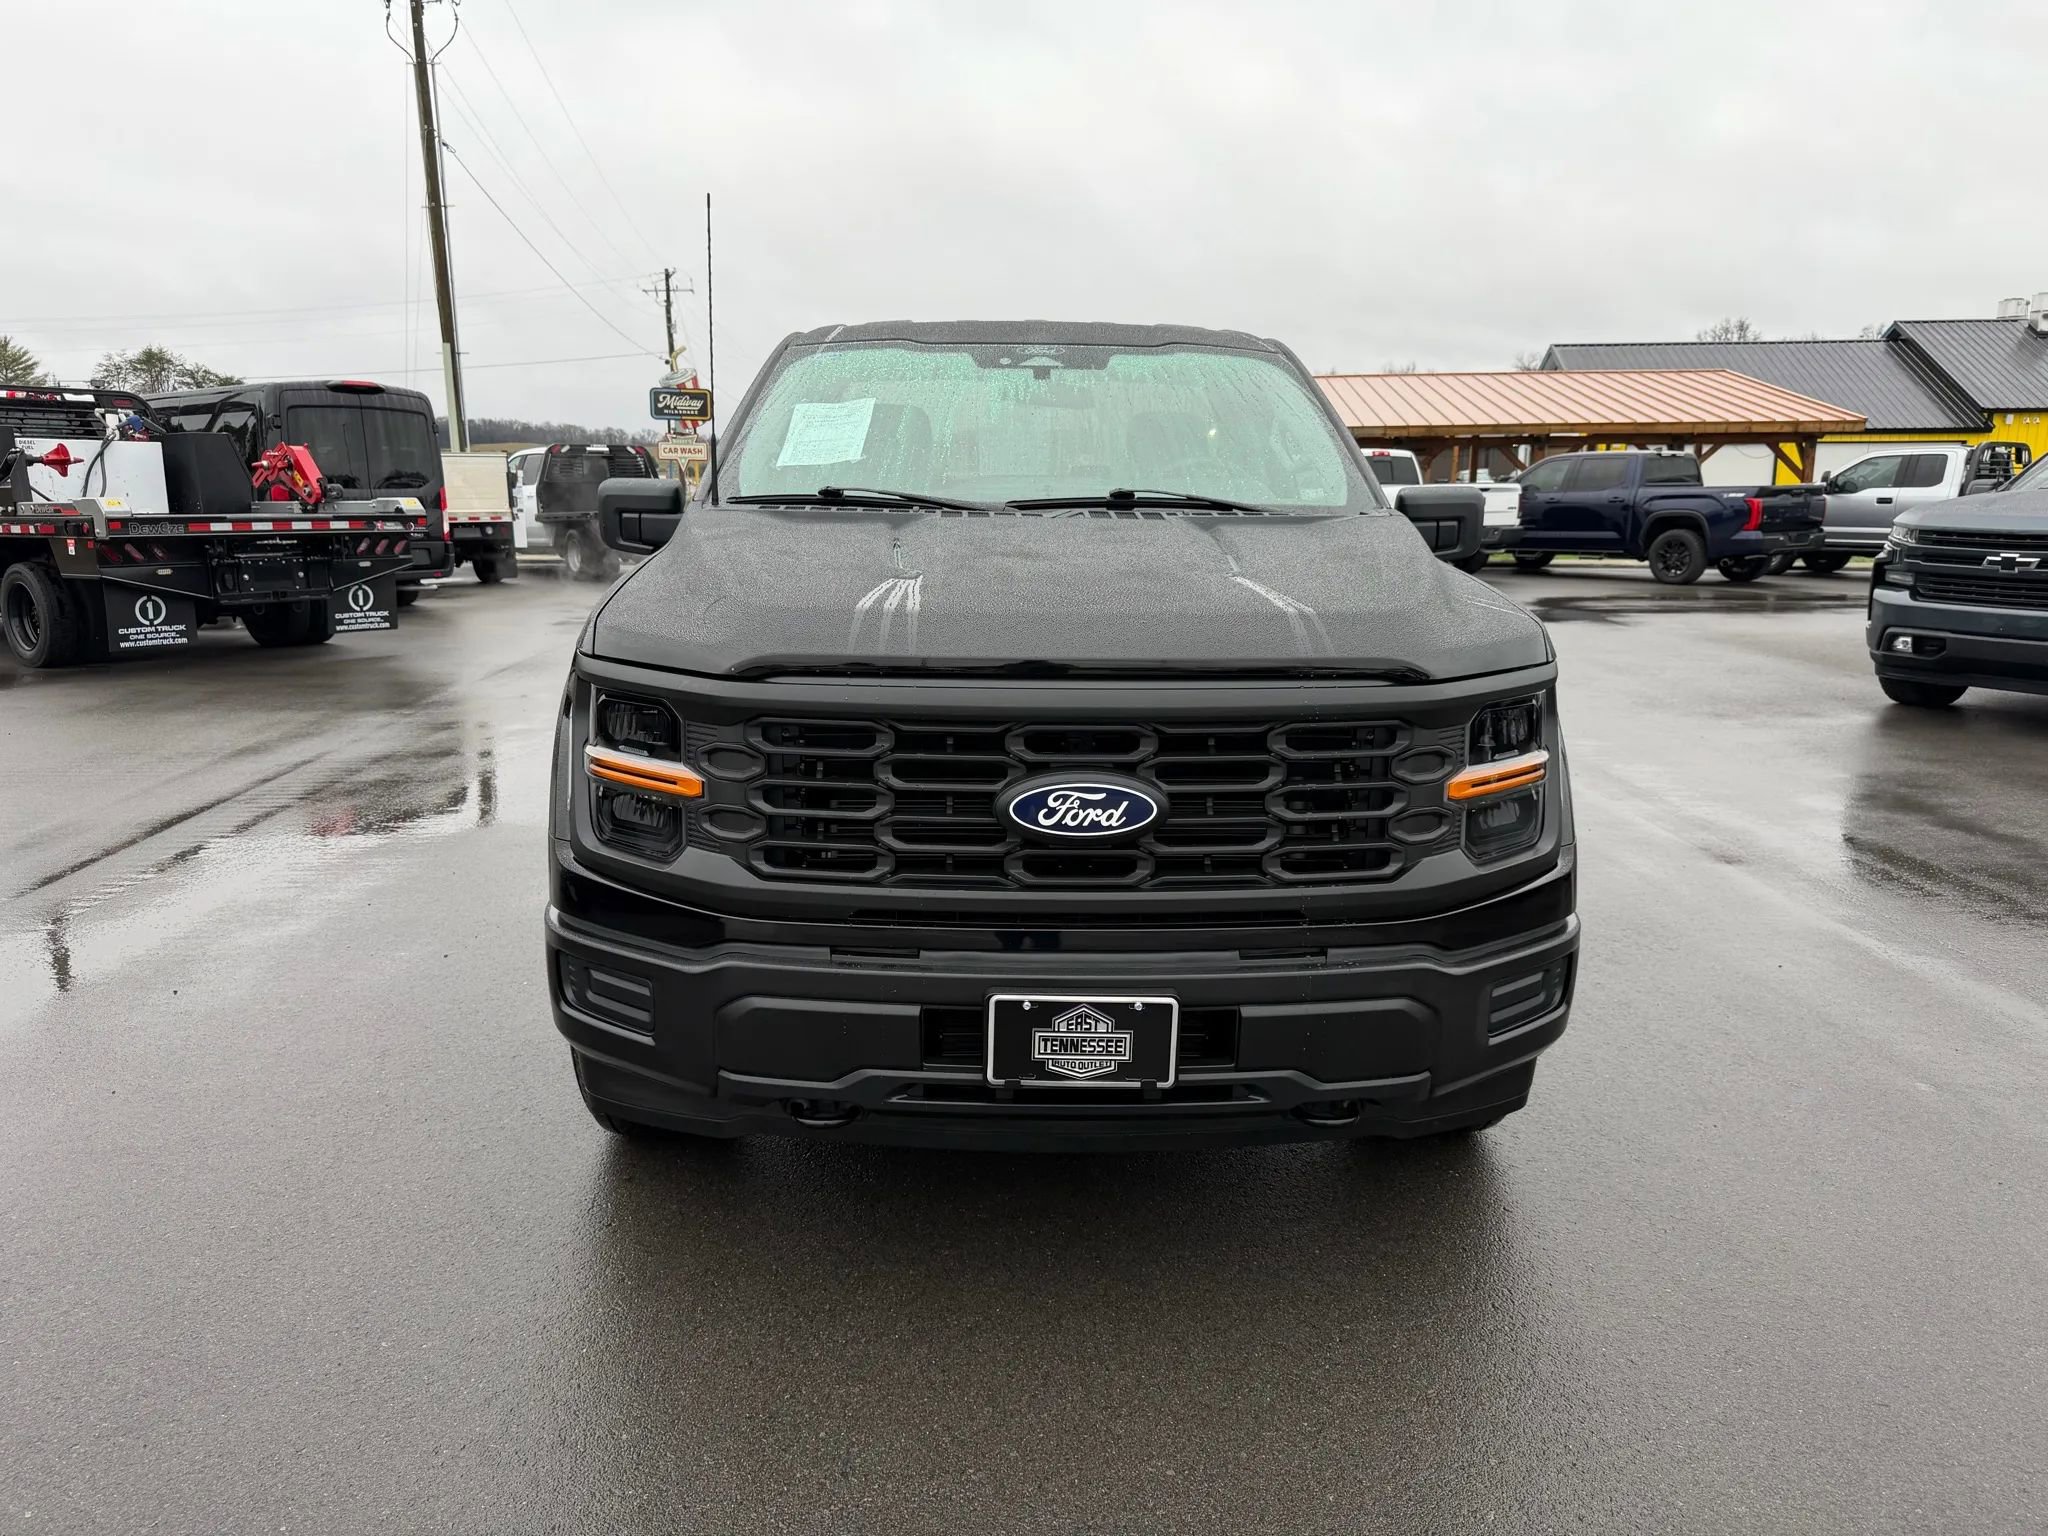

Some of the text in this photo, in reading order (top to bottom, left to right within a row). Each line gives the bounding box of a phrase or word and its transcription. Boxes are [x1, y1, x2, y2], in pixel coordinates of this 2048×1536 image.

[657, 394, 704, 410] Midway
[662, 447, 703, 455] CAR WASH
[118, 626, 156, 635] CUSTOM
[119, 637, 188, 648] www.customtruck.com
[1038, 790, 1129, 827] Ford
[1067, 1014, 1100, 1032] EAST
[1041, 1037, 1125, 1055] TENNESSEE
[1053, 1060, 1110, 1070] AUTO OUTLET
